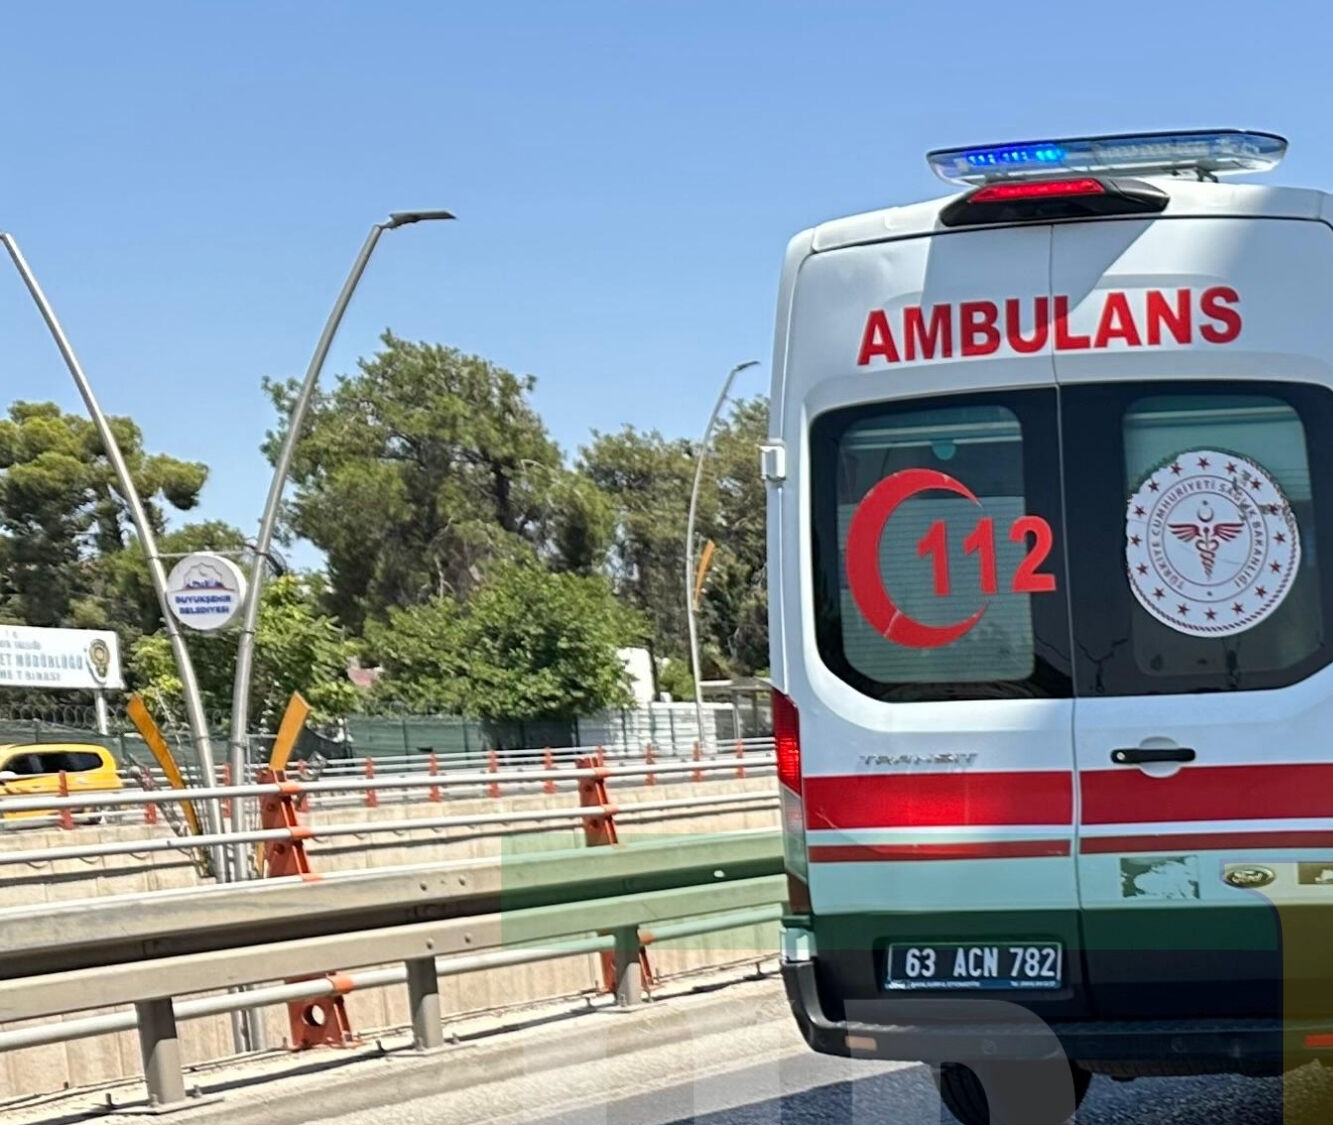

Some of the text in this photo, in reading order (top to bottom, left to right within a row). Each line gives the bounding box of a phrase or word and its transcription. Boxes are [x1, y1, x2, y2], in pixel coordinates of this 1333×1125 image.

[857, 286, 1243, 367] AMBULANS
[1152, 480, 1216, 537] CUMHURİYETİ
[916, 514, 1057, 596] 112
[1151, 542, 1184, 590] TÜRKİYE
[905, 947, 1056, 978] 63 ACN 782
